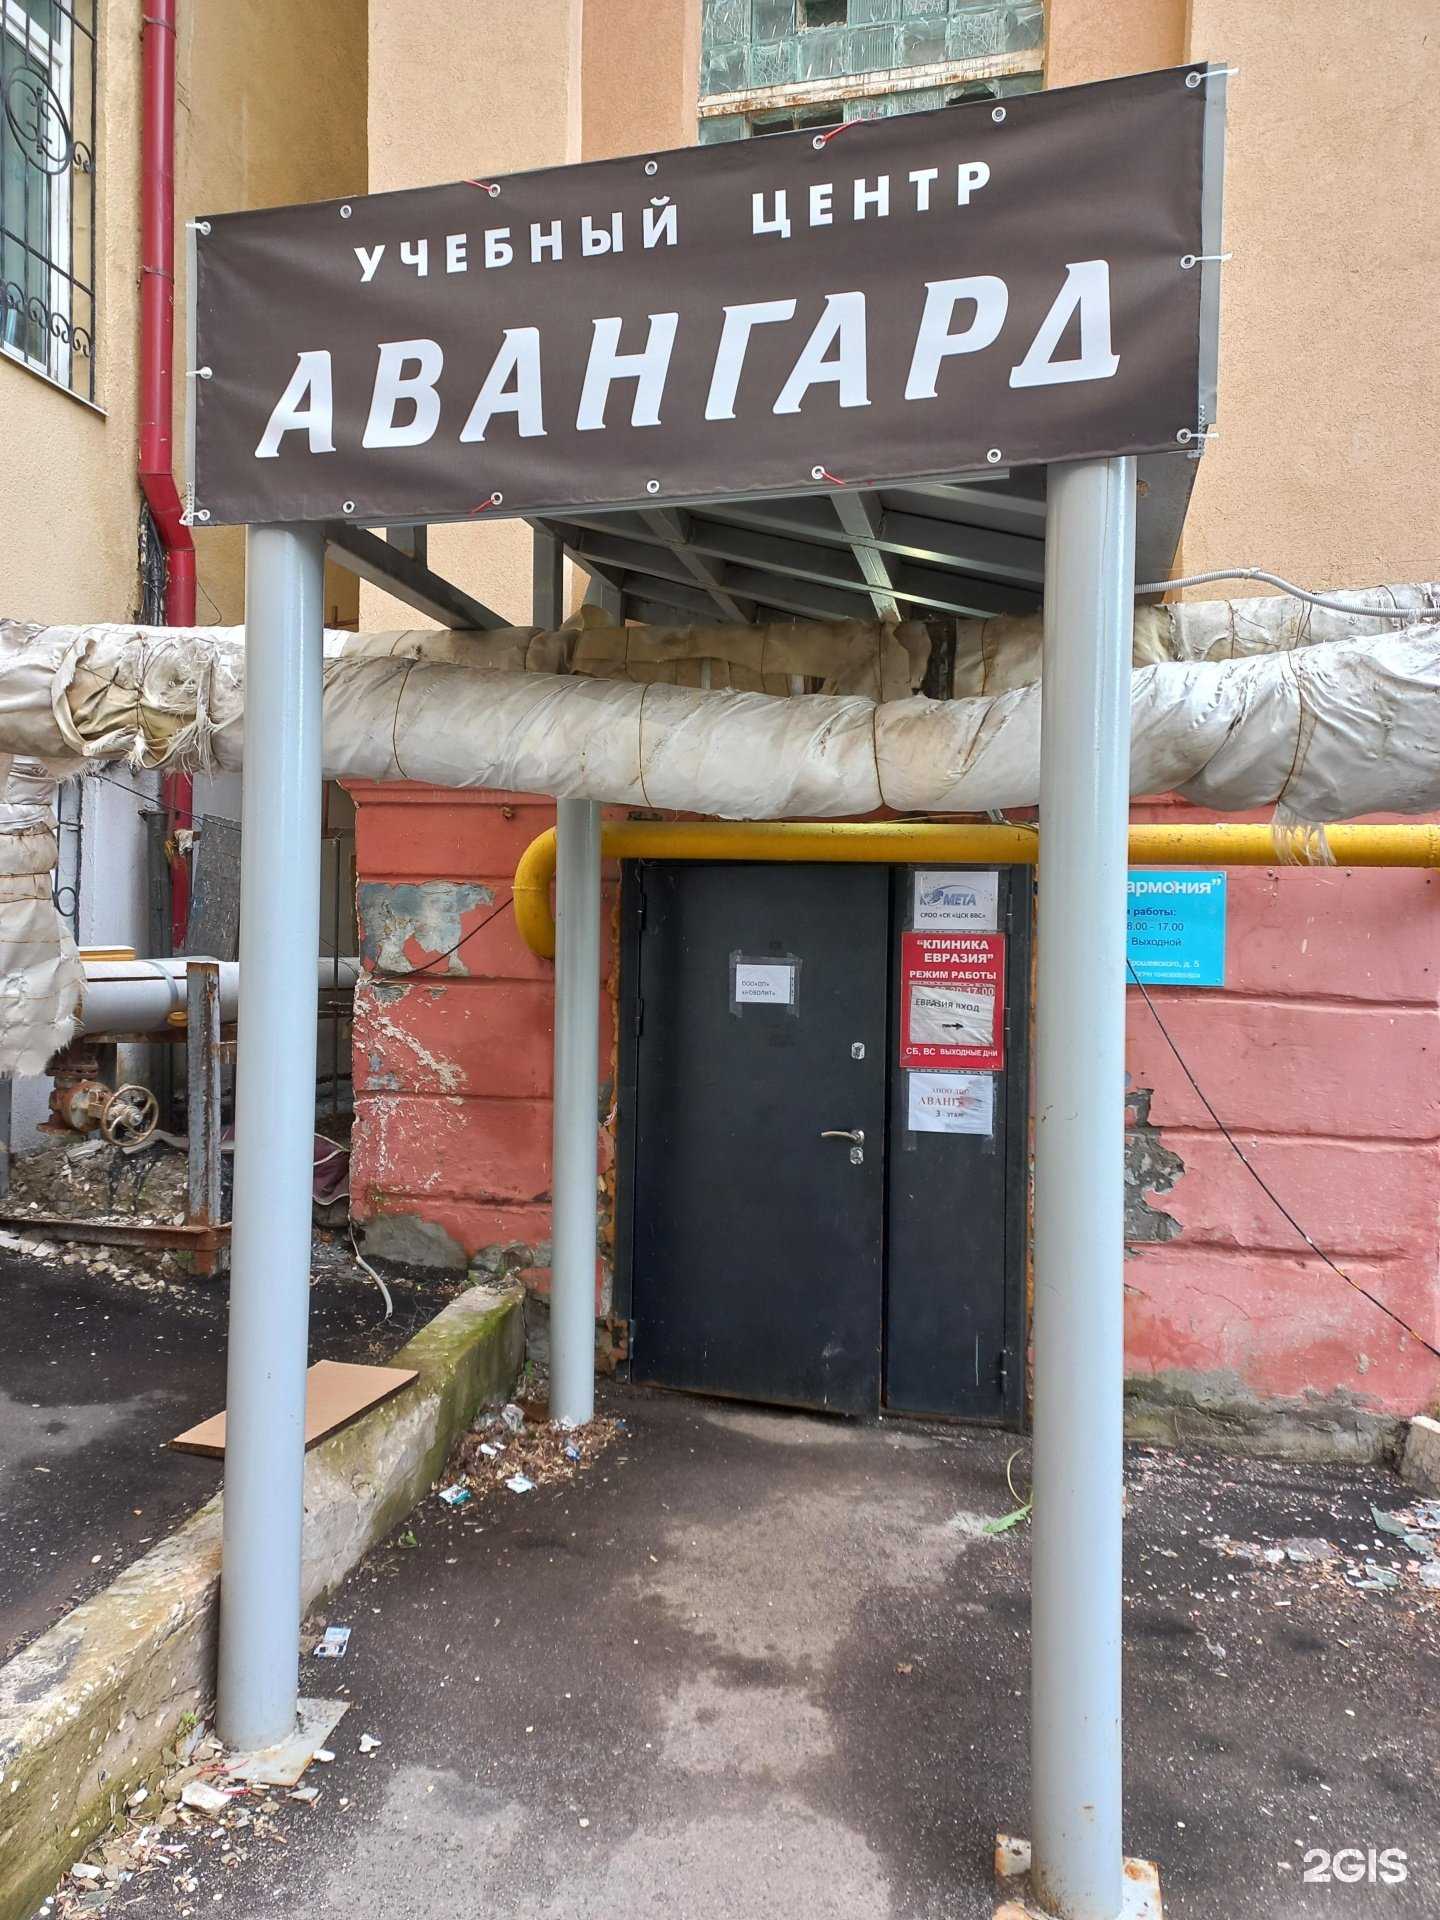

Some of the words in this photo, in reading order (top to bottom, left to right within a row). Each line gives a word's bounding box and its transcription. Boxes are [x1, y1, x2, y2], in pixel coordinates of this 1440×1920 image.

[354, 196, 679, 282] УЧЕБНЫЙ
[752, 160, 991, 238] ЦЕНТР
[254, 259, 1121, 458] АВАНГАРД
[1127, 877, 1222, 897] армония”
[1133, 906, 1177, 917] работы:
[1159, 922, 1184, 931] 17.00
[917, 939, 989, 950] “КЛИНИКА
[1131, 937, 1182, 947] Выходной
[924, 952, 994, 963] ЕВРАЗИЯ”
[909, 970, 949, 979] РЕЖИМ
[951, 971, 997, 980] РАБОТЫ
[905, 1047, 921, 1056] СБ,
[923, 1047, 936, 1056] ВС
[939, 1048, 983, 1057] ВЫХОДНЫЕ
[983, 1049, 998, 1058] ДНИ
